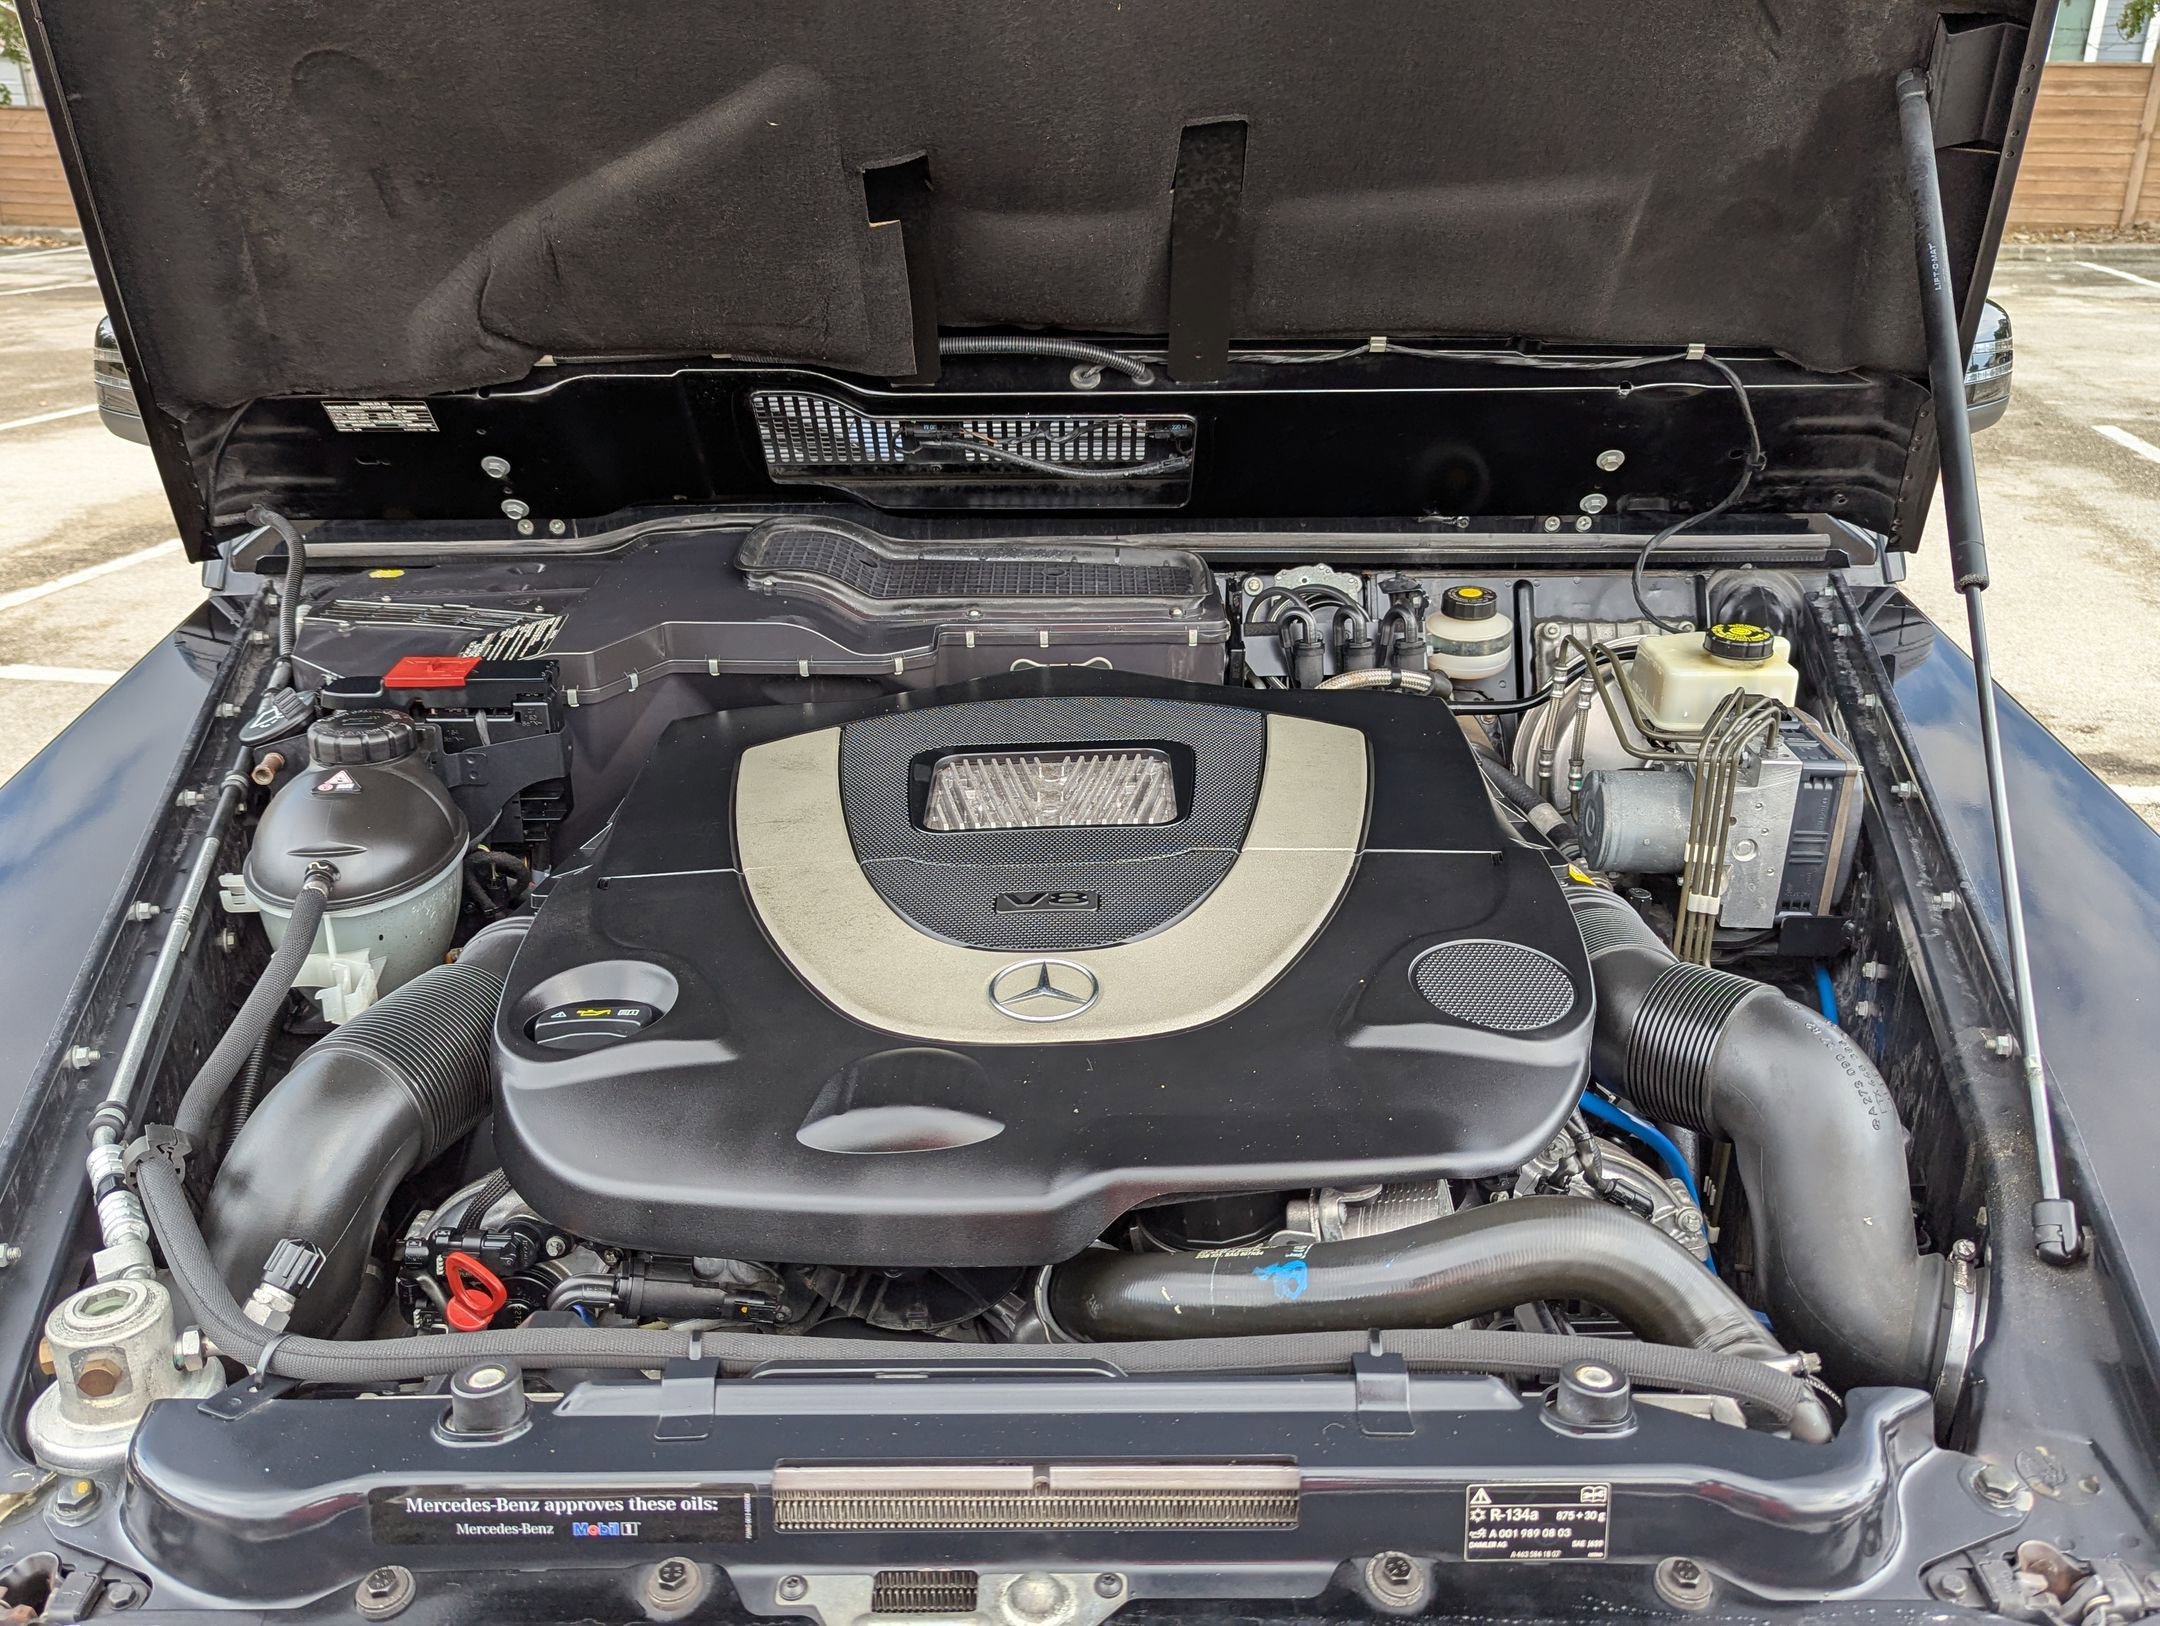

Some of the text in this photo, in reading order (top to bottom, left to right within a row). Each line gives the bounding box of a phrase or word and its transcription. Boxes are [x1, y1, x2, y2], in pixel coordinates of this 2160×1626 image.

[1002, 891, 1090, 908] V8
[405, 1497, 719, 1515] Mercedes-Benz approves these oils:
[1489, 1508, 1539, 1521] R-134a
[456, 1522, 555, 1535] Mercedes-Benz
[572, 1521, 620, 1536] Mobil
[1488, 1528, 1572, 1538] A 001 989 08 03
